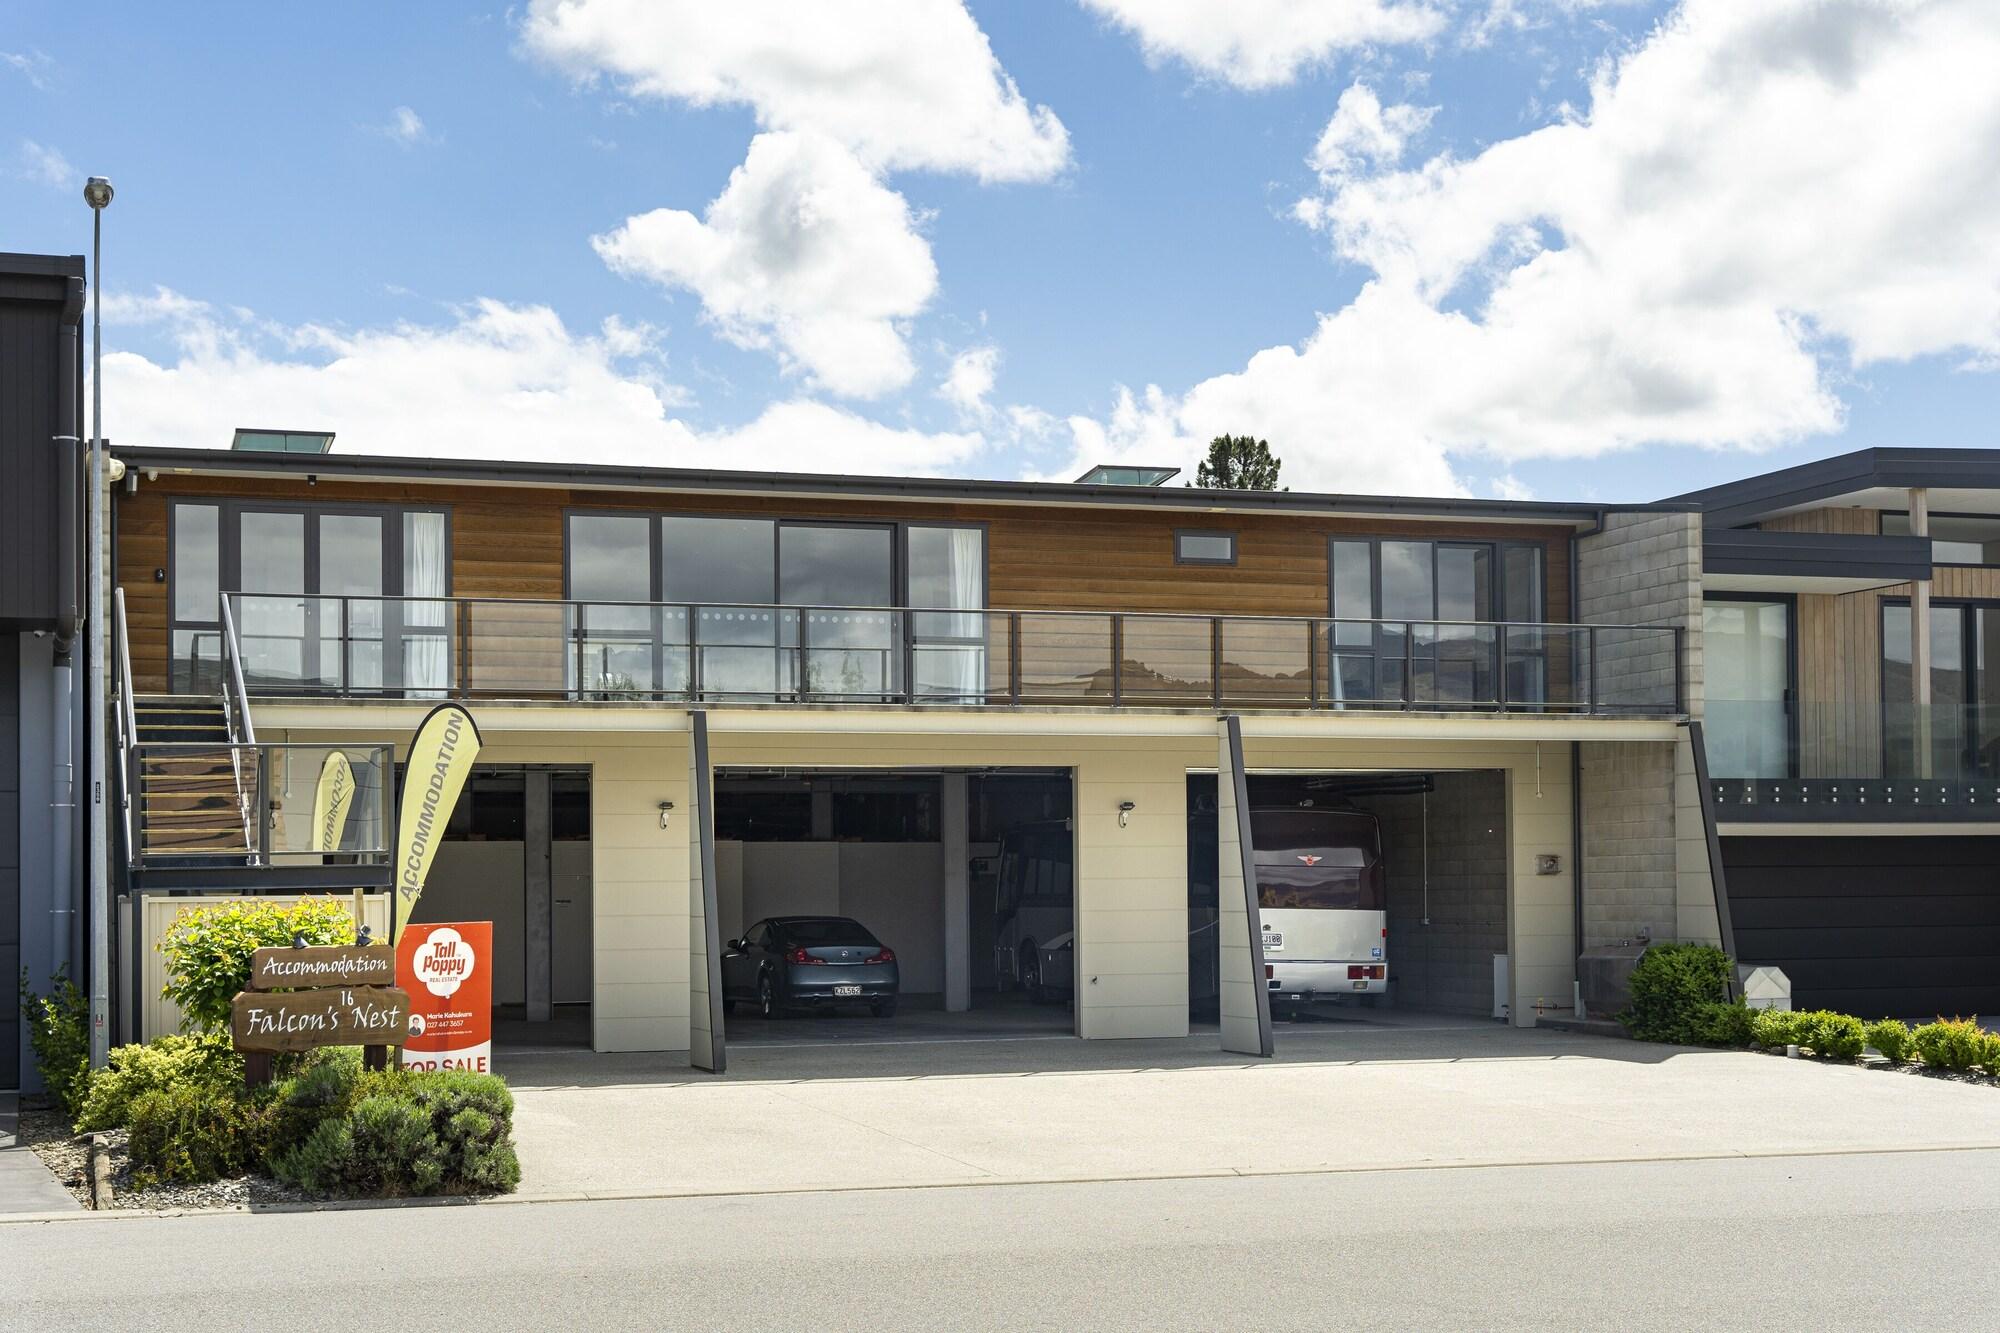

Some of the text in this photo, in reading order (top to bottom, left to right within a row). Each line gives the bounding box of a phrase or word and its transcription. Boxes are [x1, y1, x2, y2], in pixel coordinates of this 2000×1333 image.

[400, 712, 463, 902] ACCOMMODATION
[433, 941, 456, 958] Tall
[262, 954, 388, 979] Accommodation
[341, 990, 354, 1006] 16
[246, 1003, 401, 1036] Falcon's Nest
